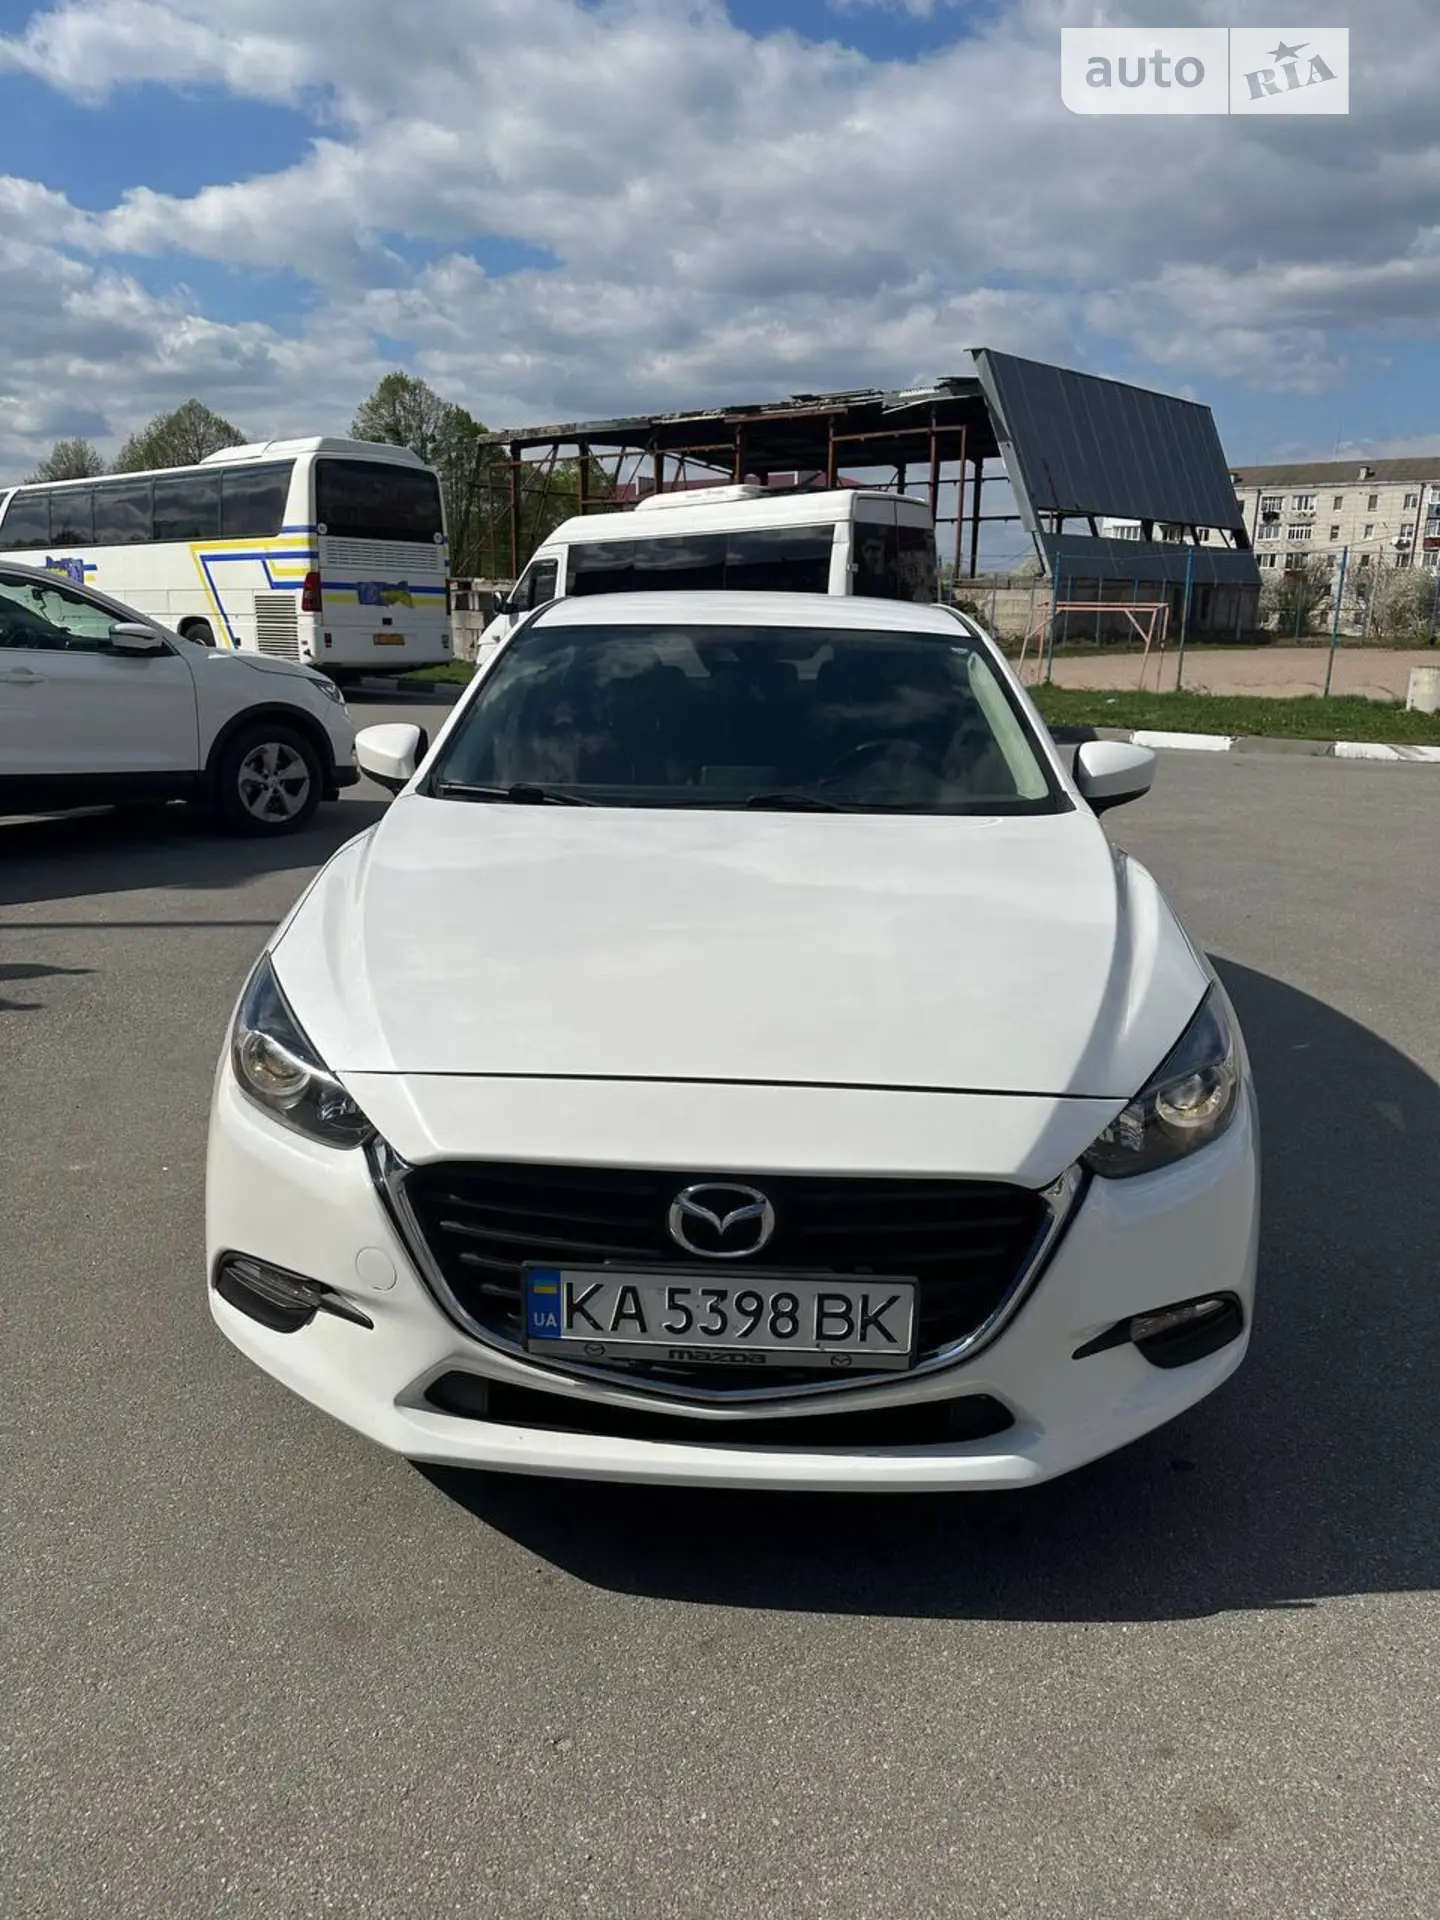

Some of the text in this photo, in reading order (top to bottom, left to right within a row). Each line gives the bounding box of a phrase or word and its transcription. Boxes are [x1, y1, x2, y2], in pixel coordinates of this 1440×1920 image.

[533, 1311, 557, 1328] UA
[563, 1281, 901, 1343] KA 5398 BK
